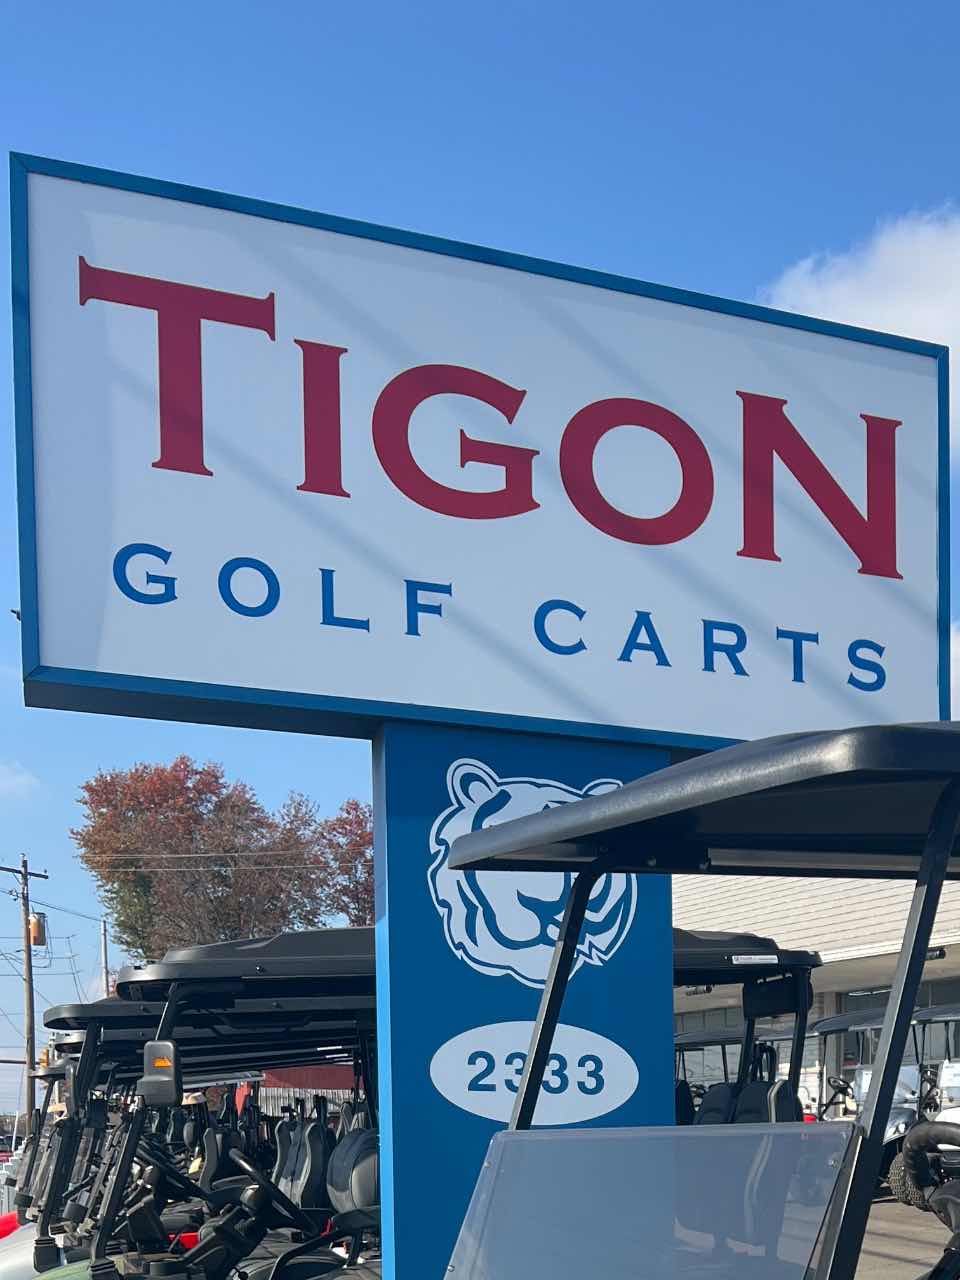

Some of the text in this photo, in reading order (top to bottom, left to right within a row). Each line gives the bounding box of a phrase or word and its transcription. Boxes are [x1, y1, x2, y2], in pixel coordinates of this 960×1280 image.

[79, 256, 904, 580] TIGON
[112, 542, 887, 693] GOLF CARTS
[467, 1050, 605, 1096] 2333
